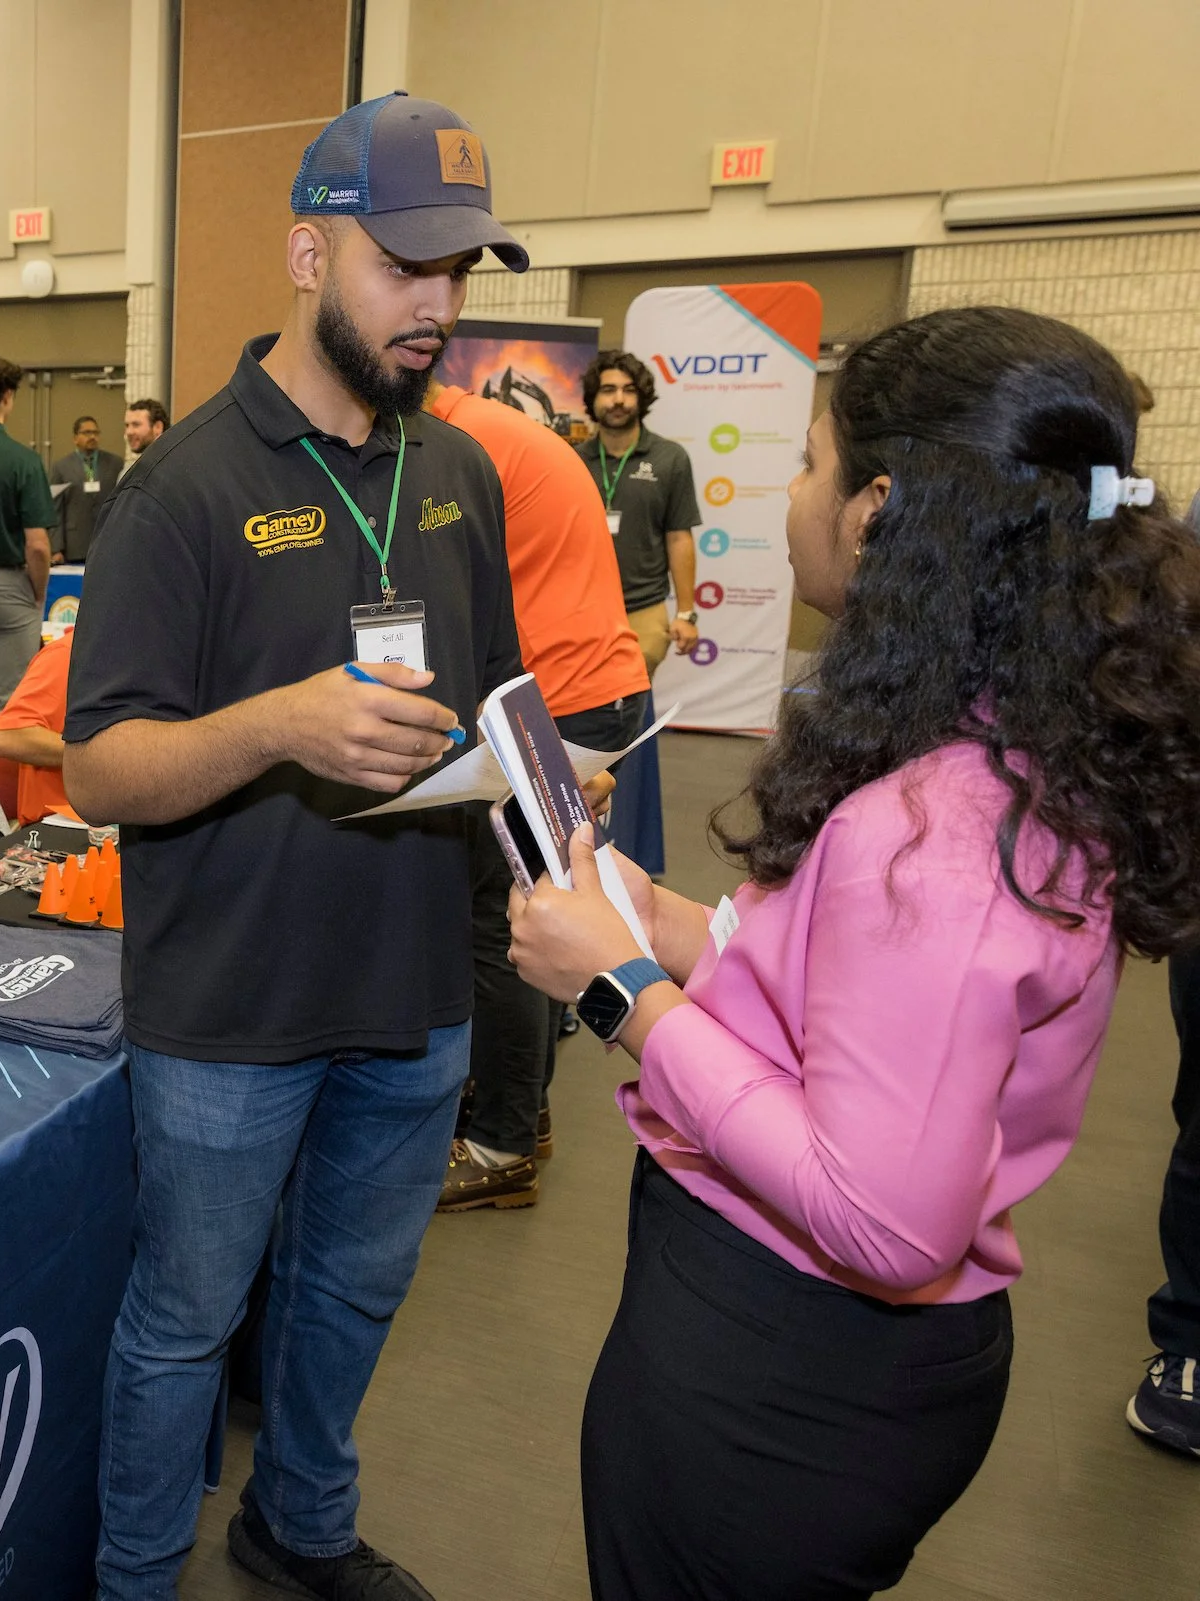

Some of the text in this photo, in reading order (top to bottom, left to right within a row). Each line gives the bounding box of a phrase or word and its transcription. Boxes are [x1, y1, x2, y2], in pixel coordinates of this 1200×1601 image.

[722, 147, 765, 178] EXIT
[329, 190, 359, 198] WARREN
[16, 213, 43, 238] EXIT
[669, 354, 768, 375] VDOT
[244, 511, 317, 542] Garney
[268, 526, 308, 540] CONSTRUCTION
[257, 547, 275, 558] 100%
[382, 633, 404, 643] Seif Ali
[384, 655, 403, 663] Garney
[537, 764, 552, 796] KNIGHTS
[560, 783, 570, 802] Jones
[548, 796, 567, 840] CORPORATE
[567, 803, 575, 818] Dow
[574, 806, 583, 824] dices
[0, 955, 74, 998] Garney
